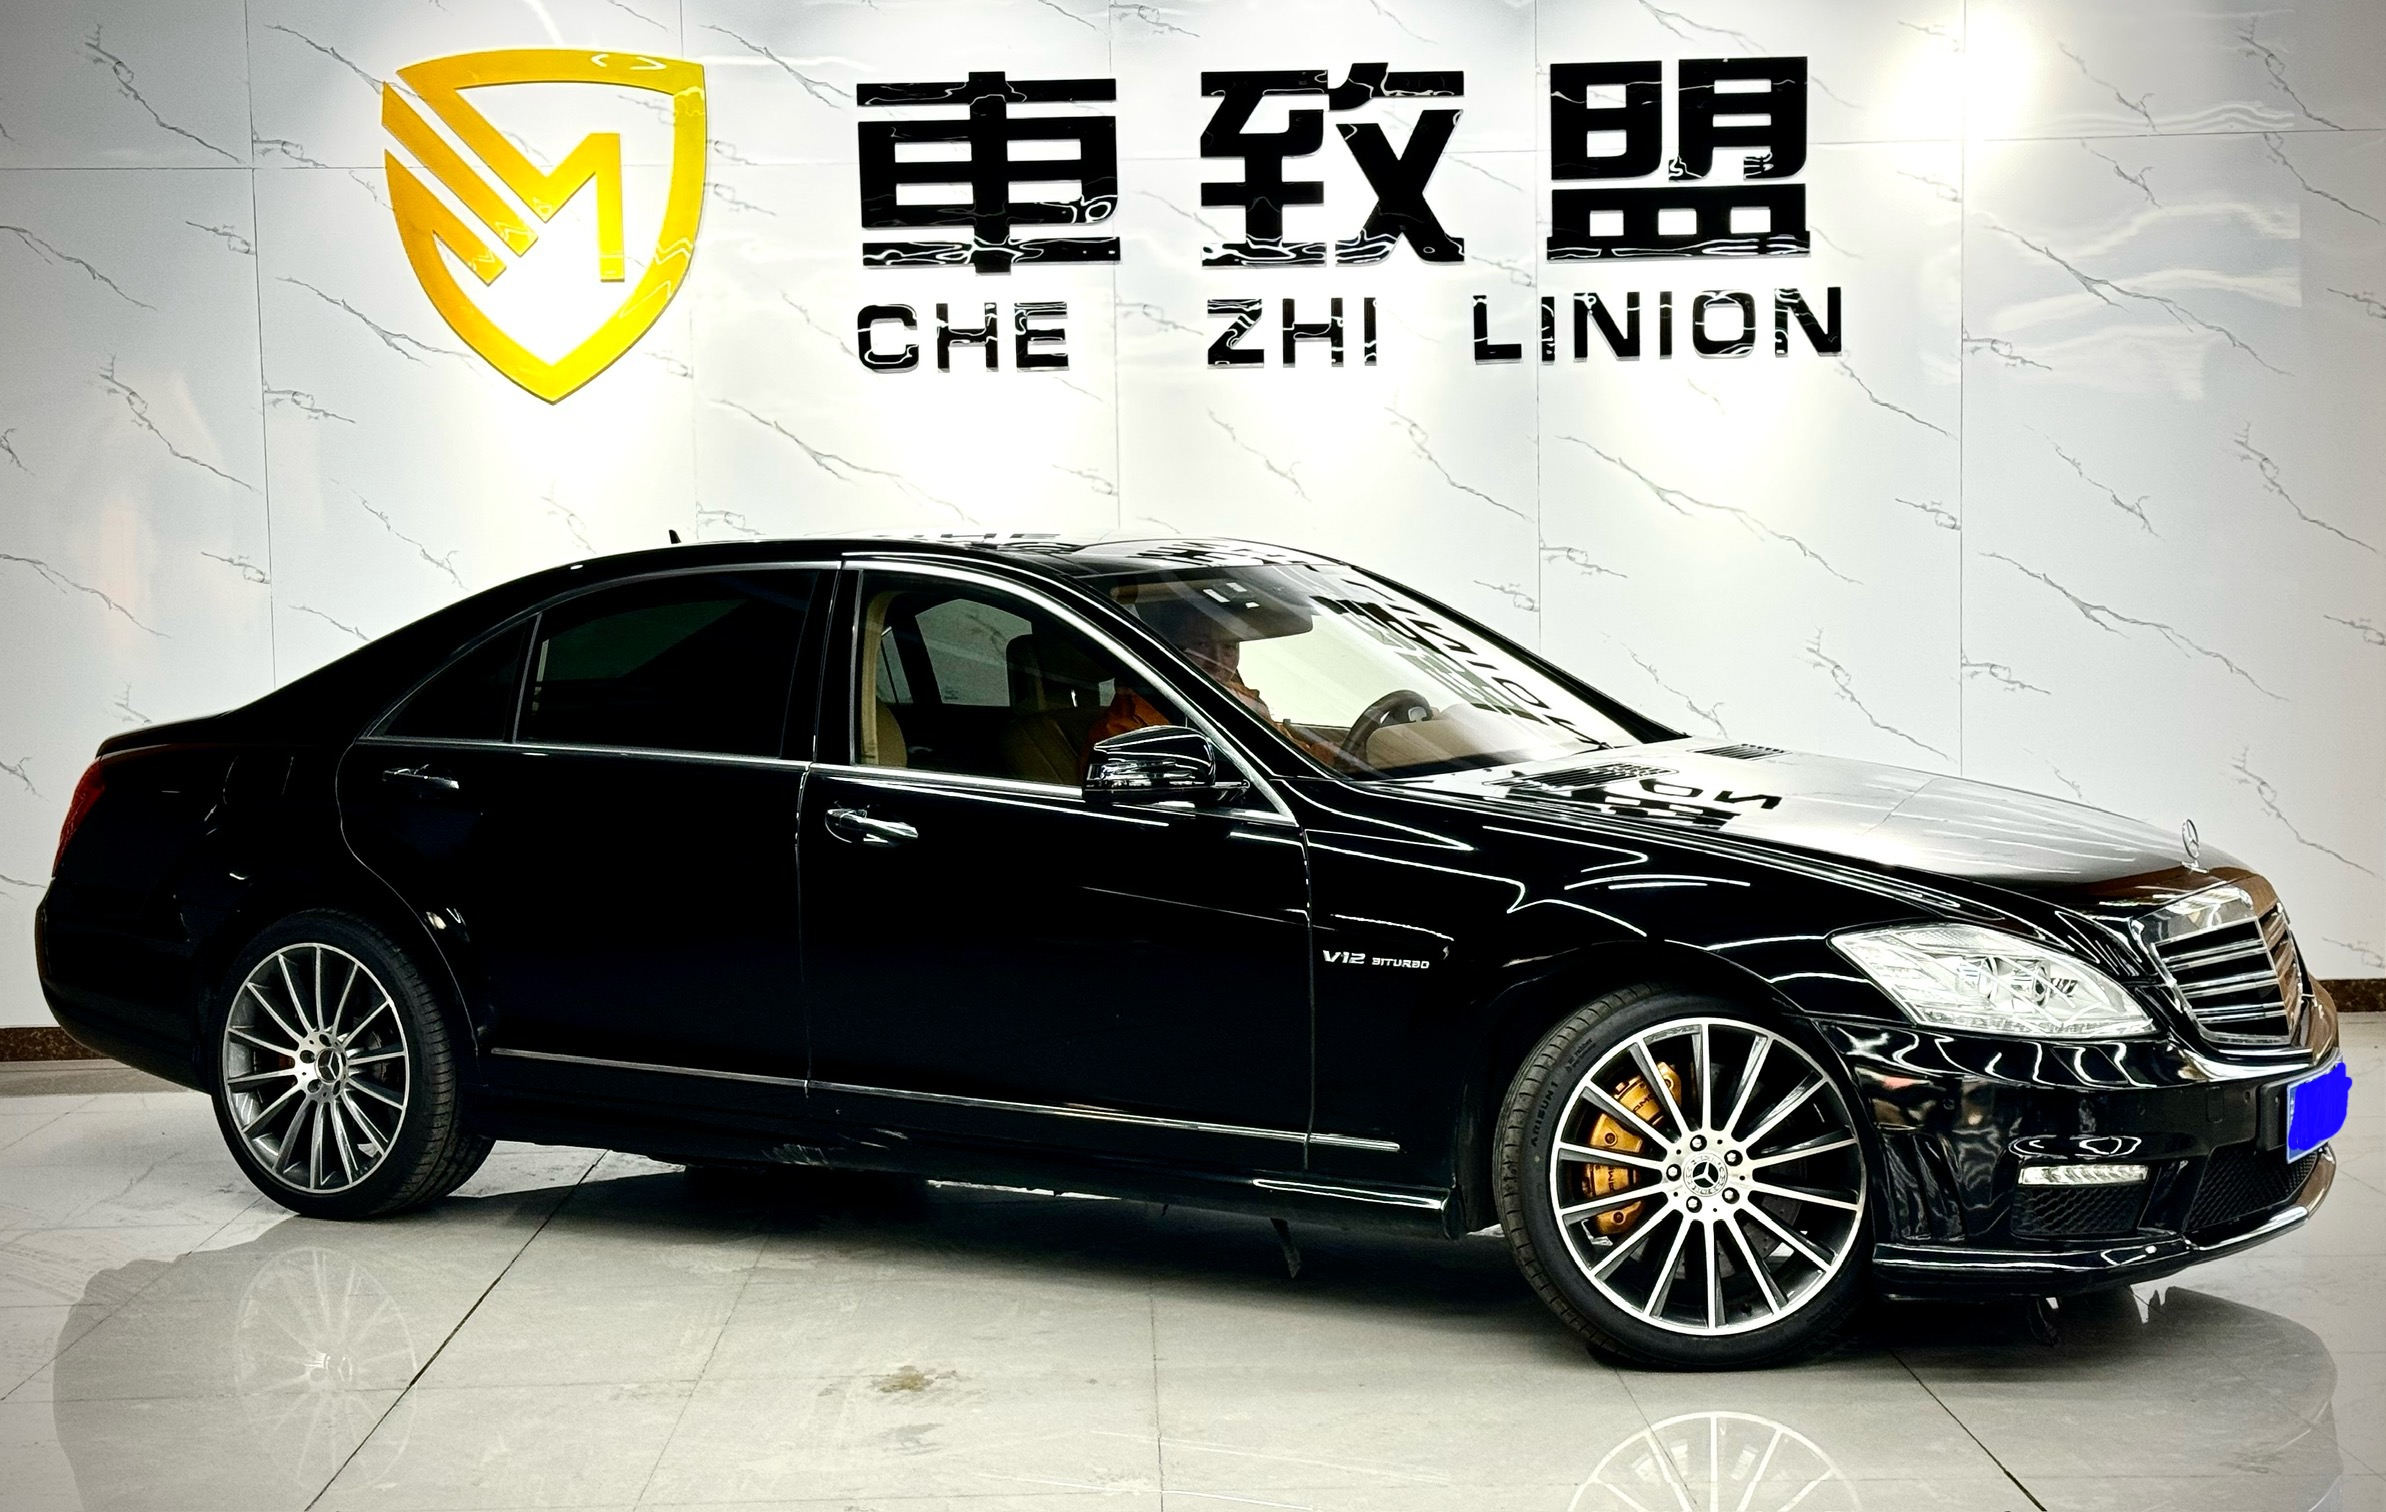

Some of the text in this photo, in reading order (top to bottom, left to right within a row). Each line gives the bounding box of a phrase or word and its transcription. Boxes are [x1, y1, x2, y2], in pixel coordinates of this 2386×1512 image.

[858, 287, 1841, 372] CHE ZHI LINION
[1322, 949, 1430, 969] V12 BITURBO
